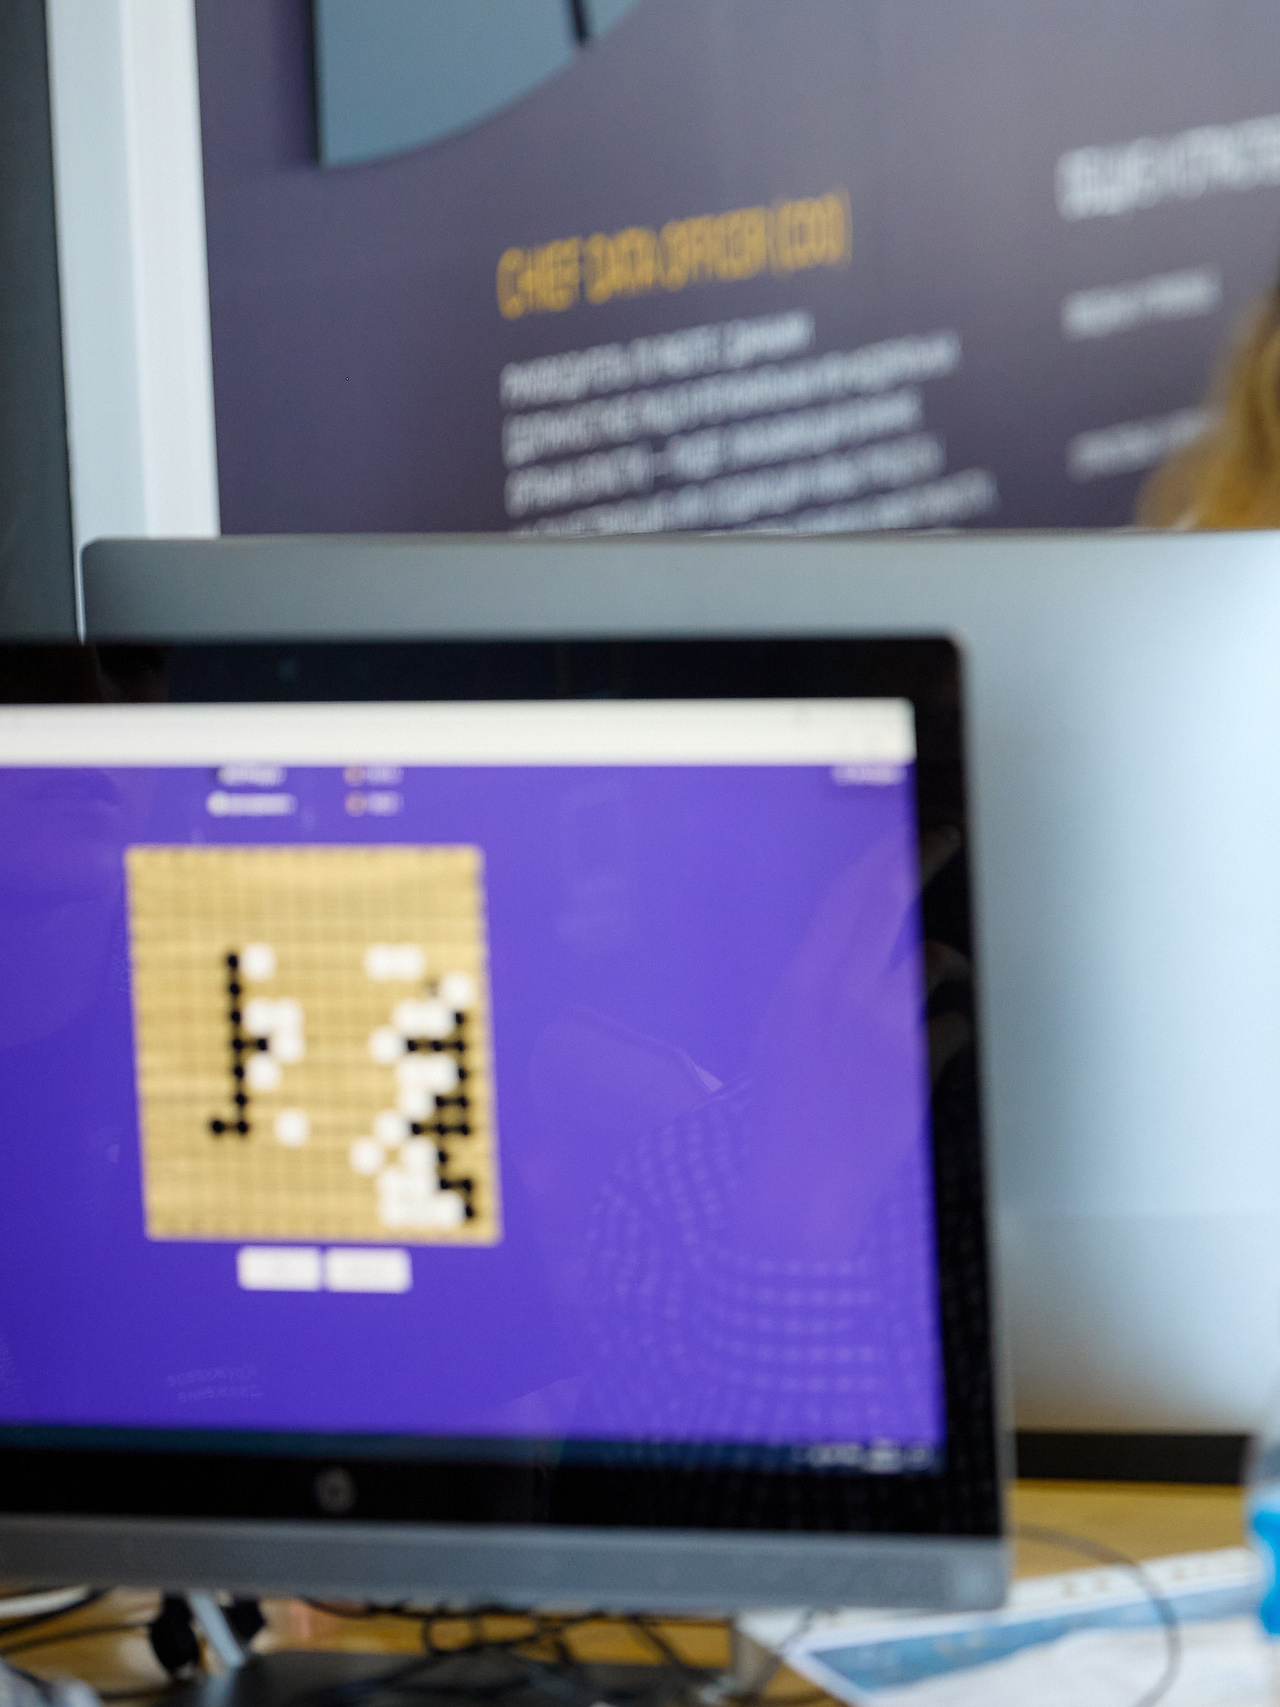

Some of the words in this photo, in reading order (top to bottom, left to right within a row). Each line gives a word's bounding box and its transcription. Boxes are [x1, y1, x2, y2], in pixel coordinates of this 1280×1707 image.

[498, 237, 584, 319] CHIEF
[585, 223, 660, 305] DATA
[658, 205, 770, 293] OFFICER
